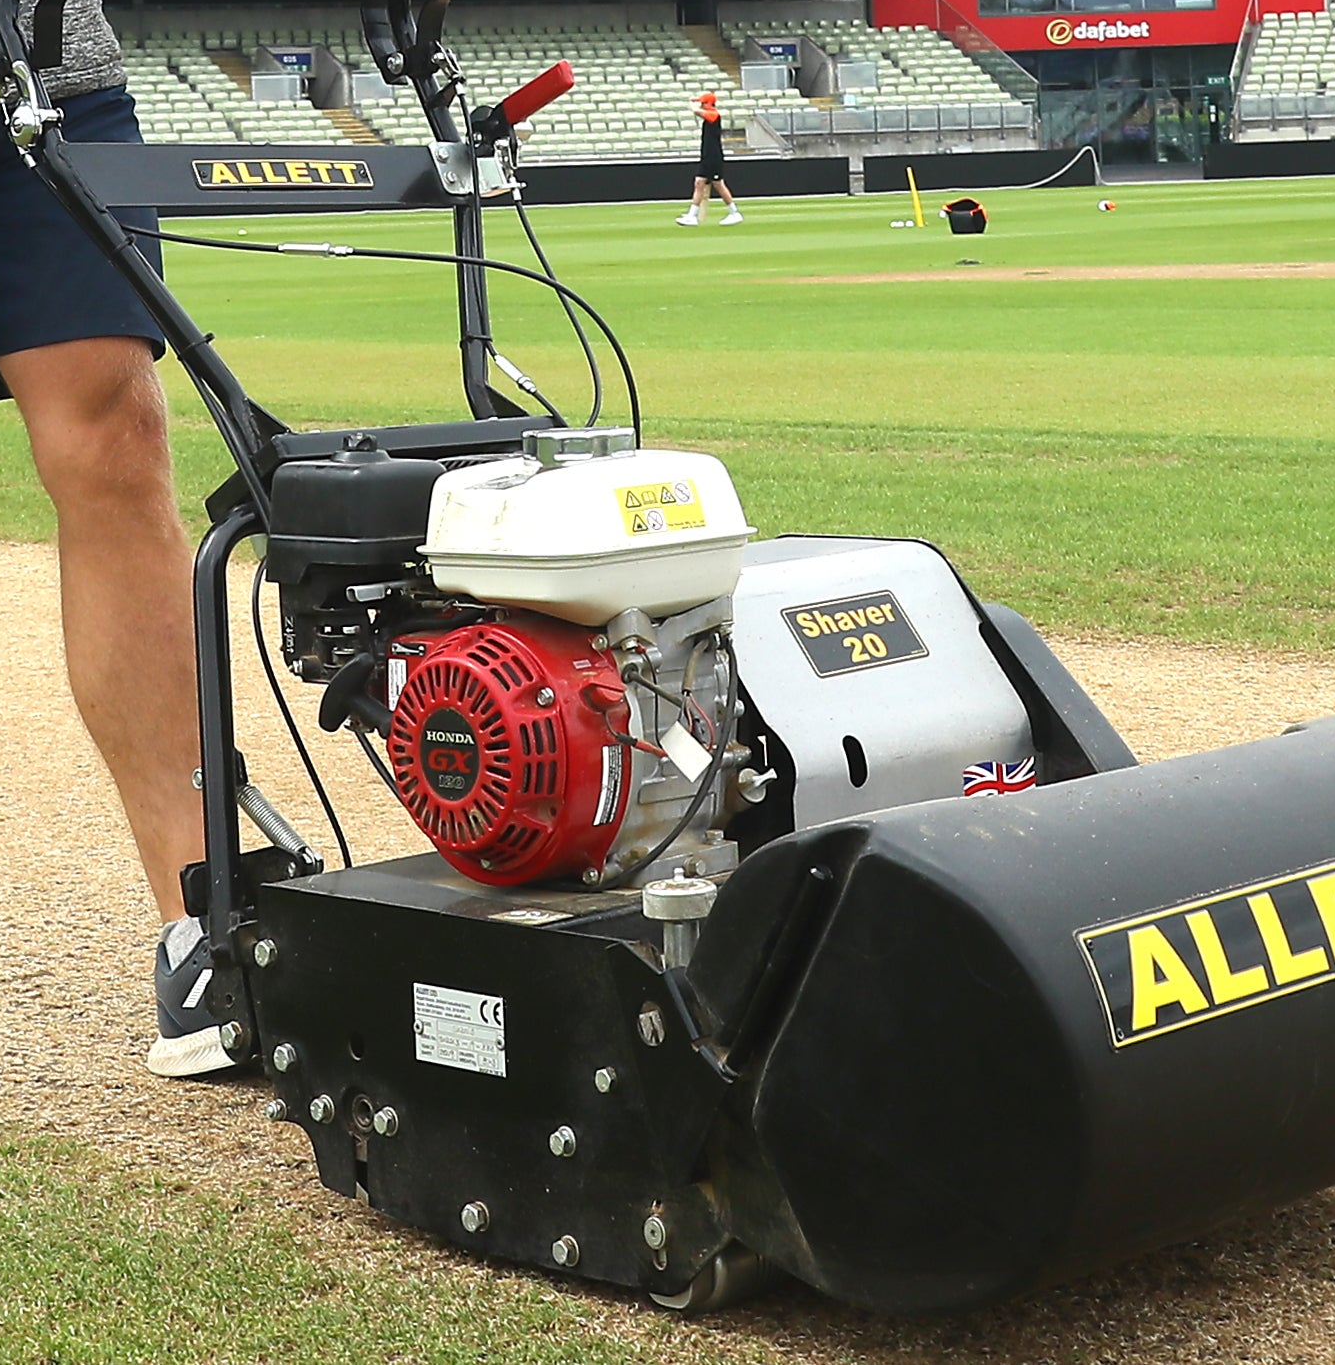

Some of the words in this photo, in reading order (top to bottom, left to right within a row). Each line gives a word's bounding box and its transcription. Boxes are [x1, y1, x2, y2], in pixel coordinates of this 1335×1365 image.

[1073, 20, 1150, 42] dafabet
[211, 162, 357, 184] ALLETT
[795, 602, 896, 638] Shaver
[842, 632, 888, 664] 20
[426, 730, 475, 745] HONDA
[428, 747, 473, 774] GX
[479, 999, 503, 1027] CE
